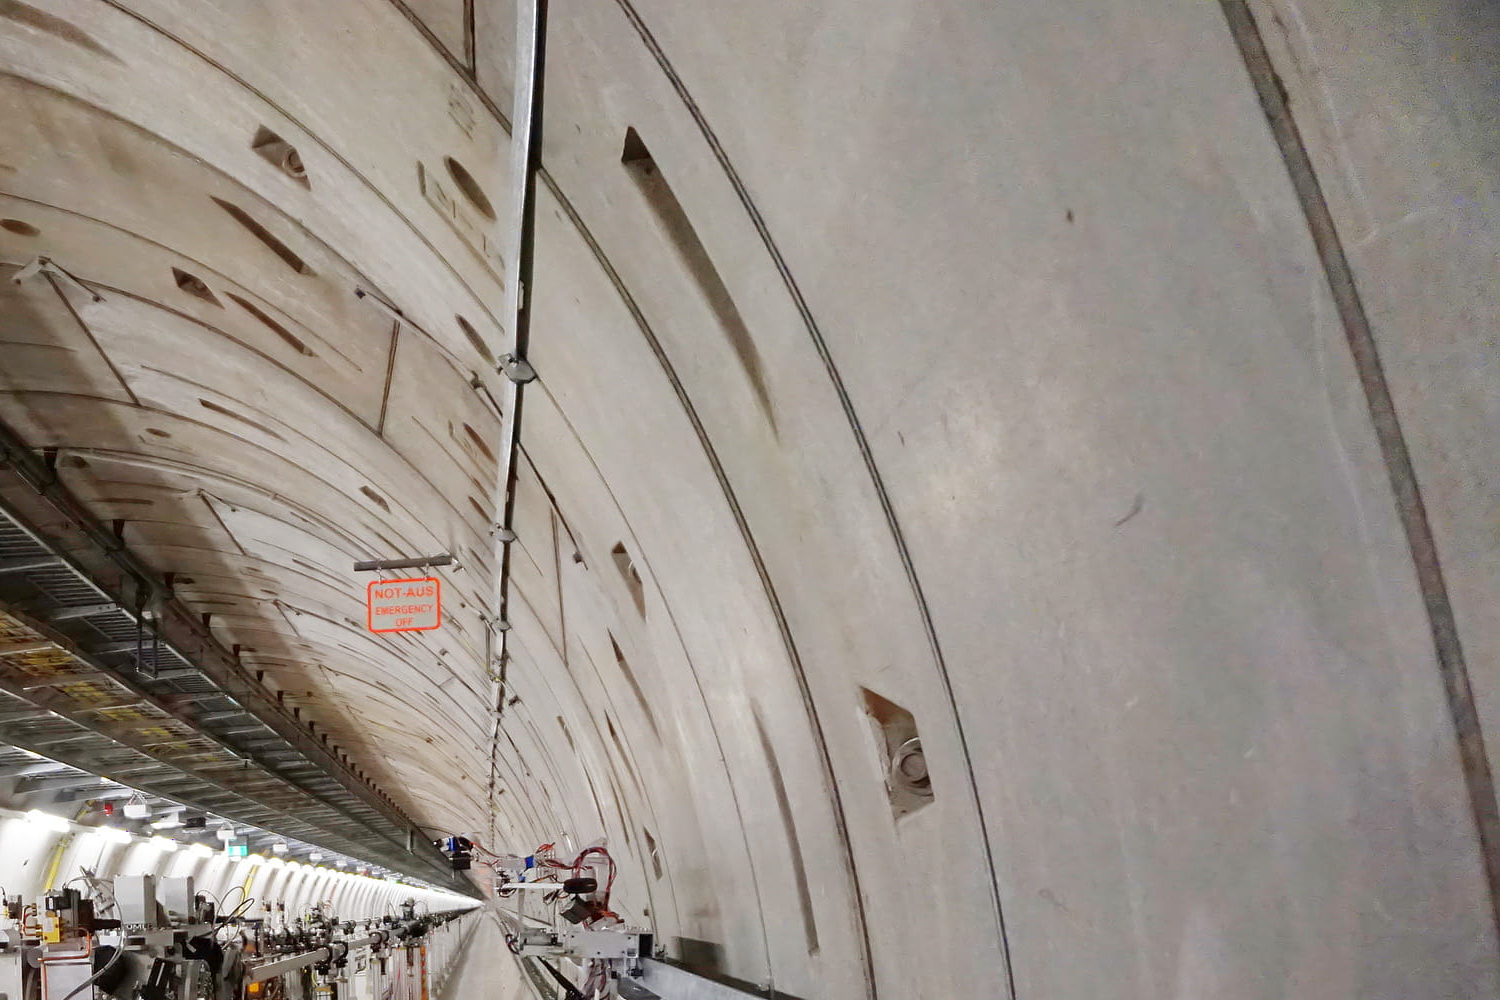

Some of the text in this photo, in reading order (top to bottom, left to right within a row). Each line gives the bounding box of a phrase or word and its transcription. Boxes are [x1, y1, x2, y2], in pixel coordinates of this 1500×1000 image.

[375, 586, 435, 599] NOT-AUS
[375, 604, 433, 616] EMERGENCY
[395, 617, 415, 627] OFF
